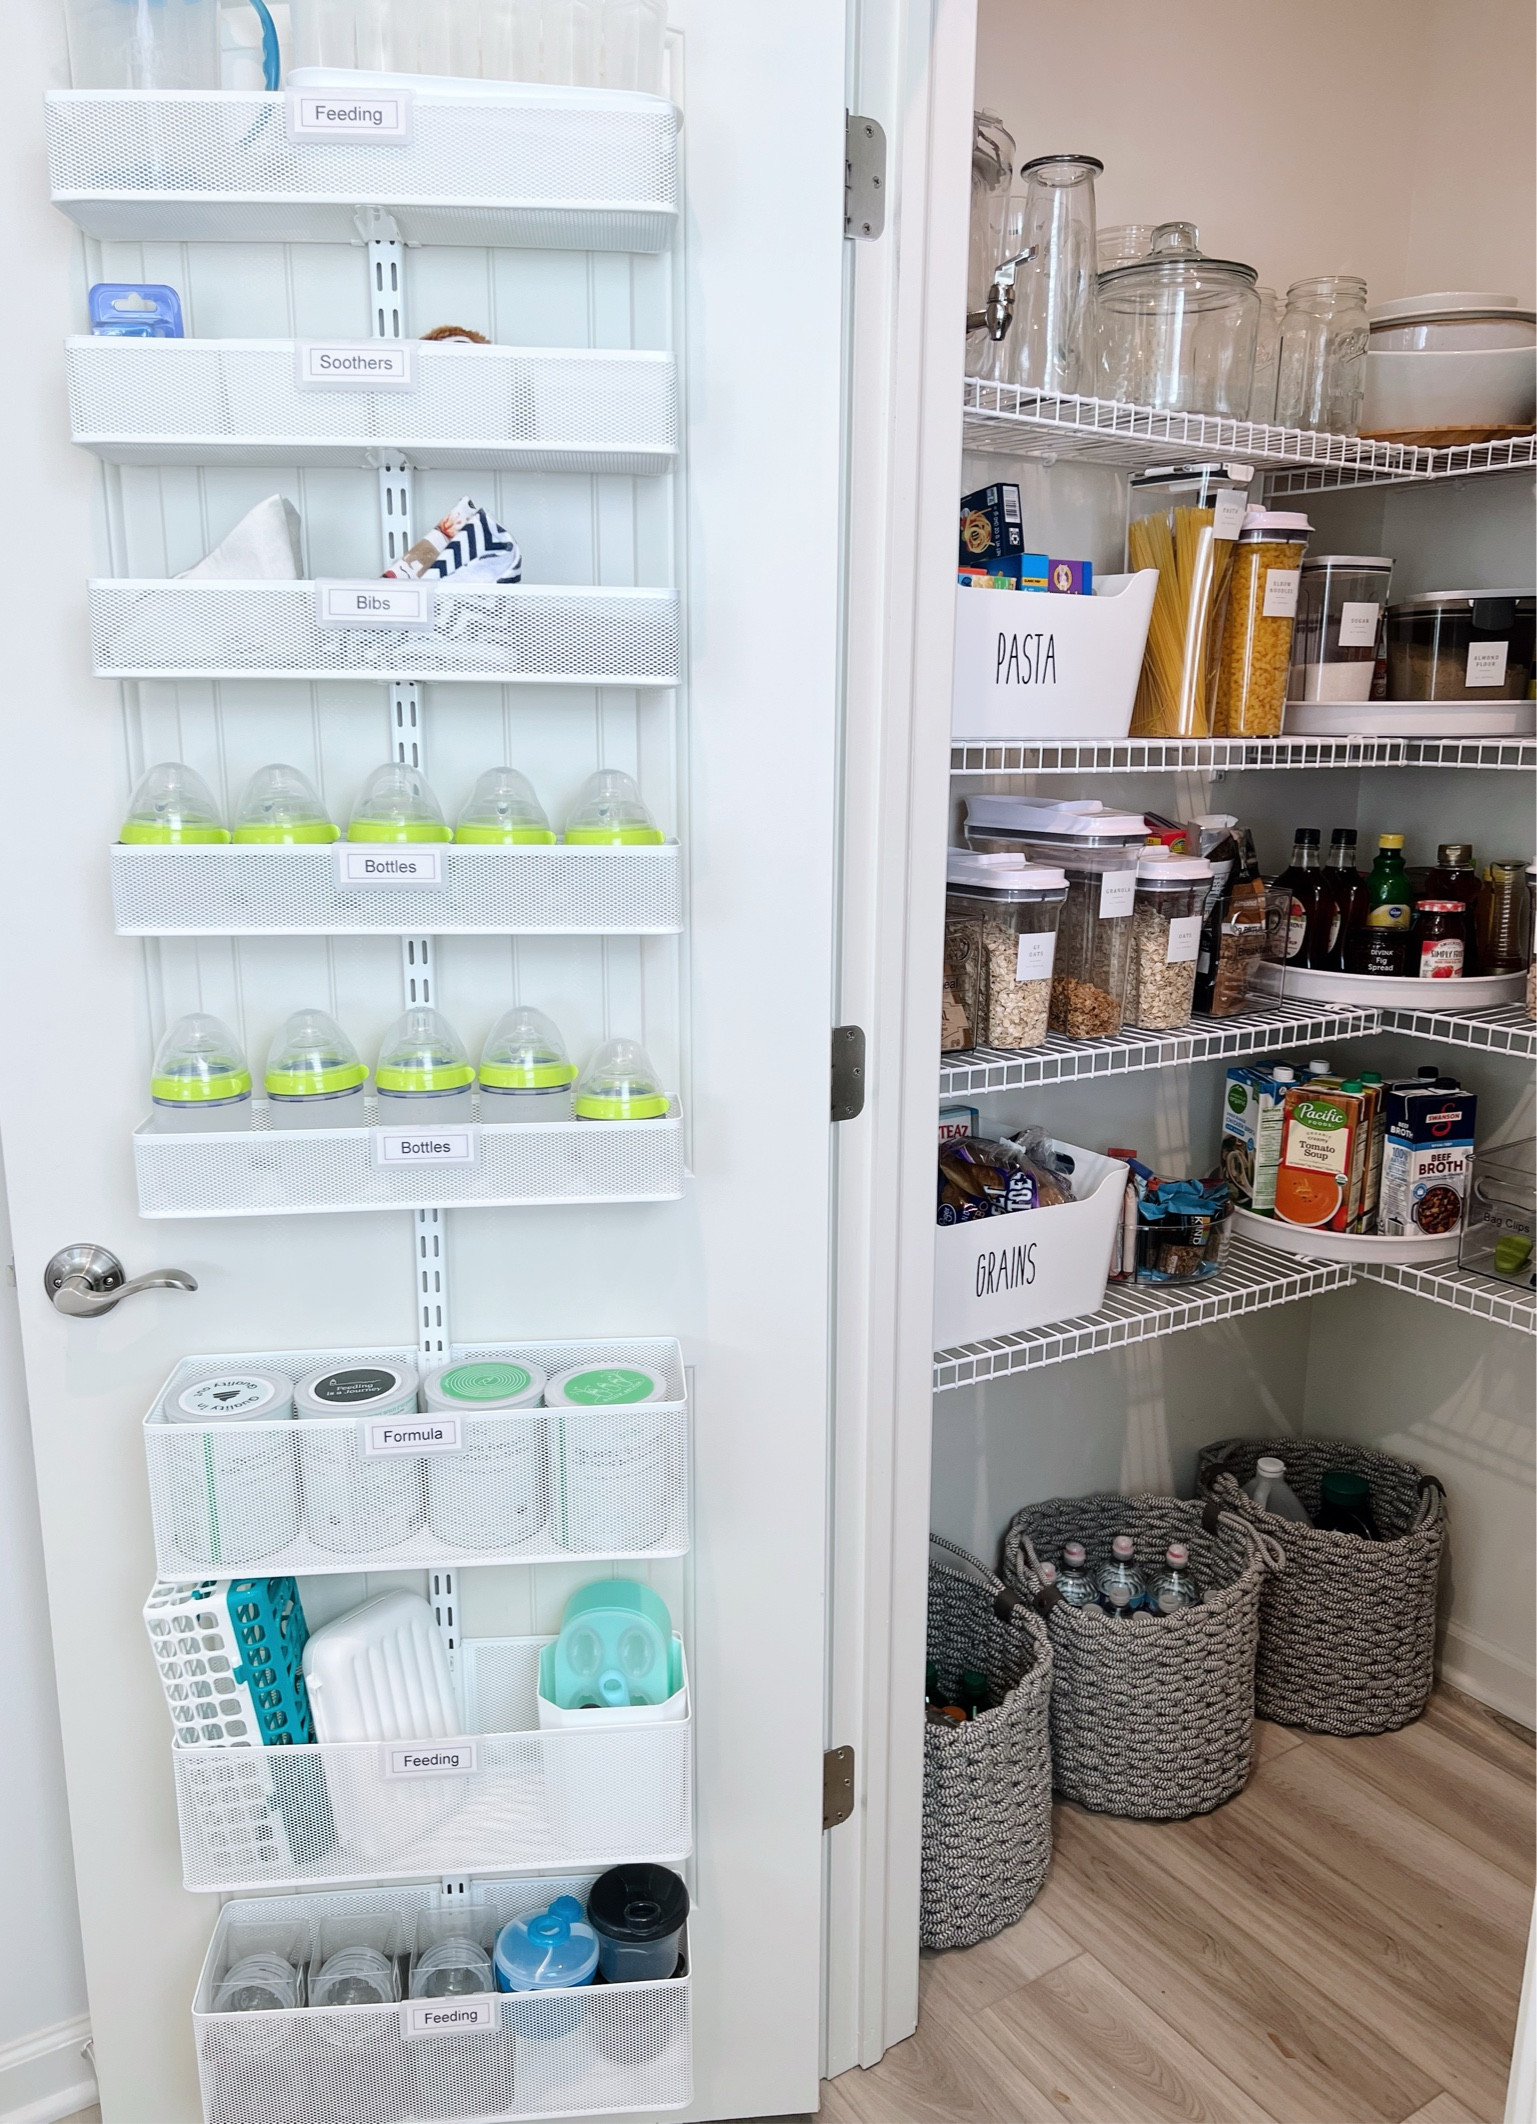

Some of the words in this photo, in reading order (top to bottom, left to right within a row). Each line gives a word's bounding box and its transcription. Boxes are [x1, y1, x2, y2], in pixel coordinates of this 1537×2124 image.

[315, 105, 383, 125] Feeding
[320, 354, 394, 370] Soothers
[356, 595, 391, 610] Bibs
[995, 632, 1056, 685] PASTA
[365, 859, 417, 873] Bottles
[1105, 887, 1131, 895] GRANOLA
[1367, 963, 1394, 971] Spread
[1375, 956, 1388, 966] Fig
[1299, 1103, 1343, 1123] Pacific
[1428, 1113, 1460, 1122] SWANSON
[1390, 1126, 1414, 1139] BROTH
[401, 1141, 451, 1154] Bottles
[1299, 1141, 1336, 1154] Tomato
[1304, 1149, 1329, 1161] Soup
[1431, 1153, 1452, 1161] BEEF
[1419, 1160, 1464, 1175] BROTH
[1483, 1211, 1503, 1228] Bag
[1505, 1218, 1531, 1233] Clips
[1193, 1216, 1205, 1246] KIND
[976, 1242, 1038, 1298] GRAINS
[336, 1383, 374, 1391] Feeding
[344, 1387, 382, 1395] Journey
[210, 1396, 260, 1411] Quality
[383, 1427, 443, 1443] Formula
[404, 1753, 459, 1767] Feeding
[424, 2010, 478, 2025] Feeding
